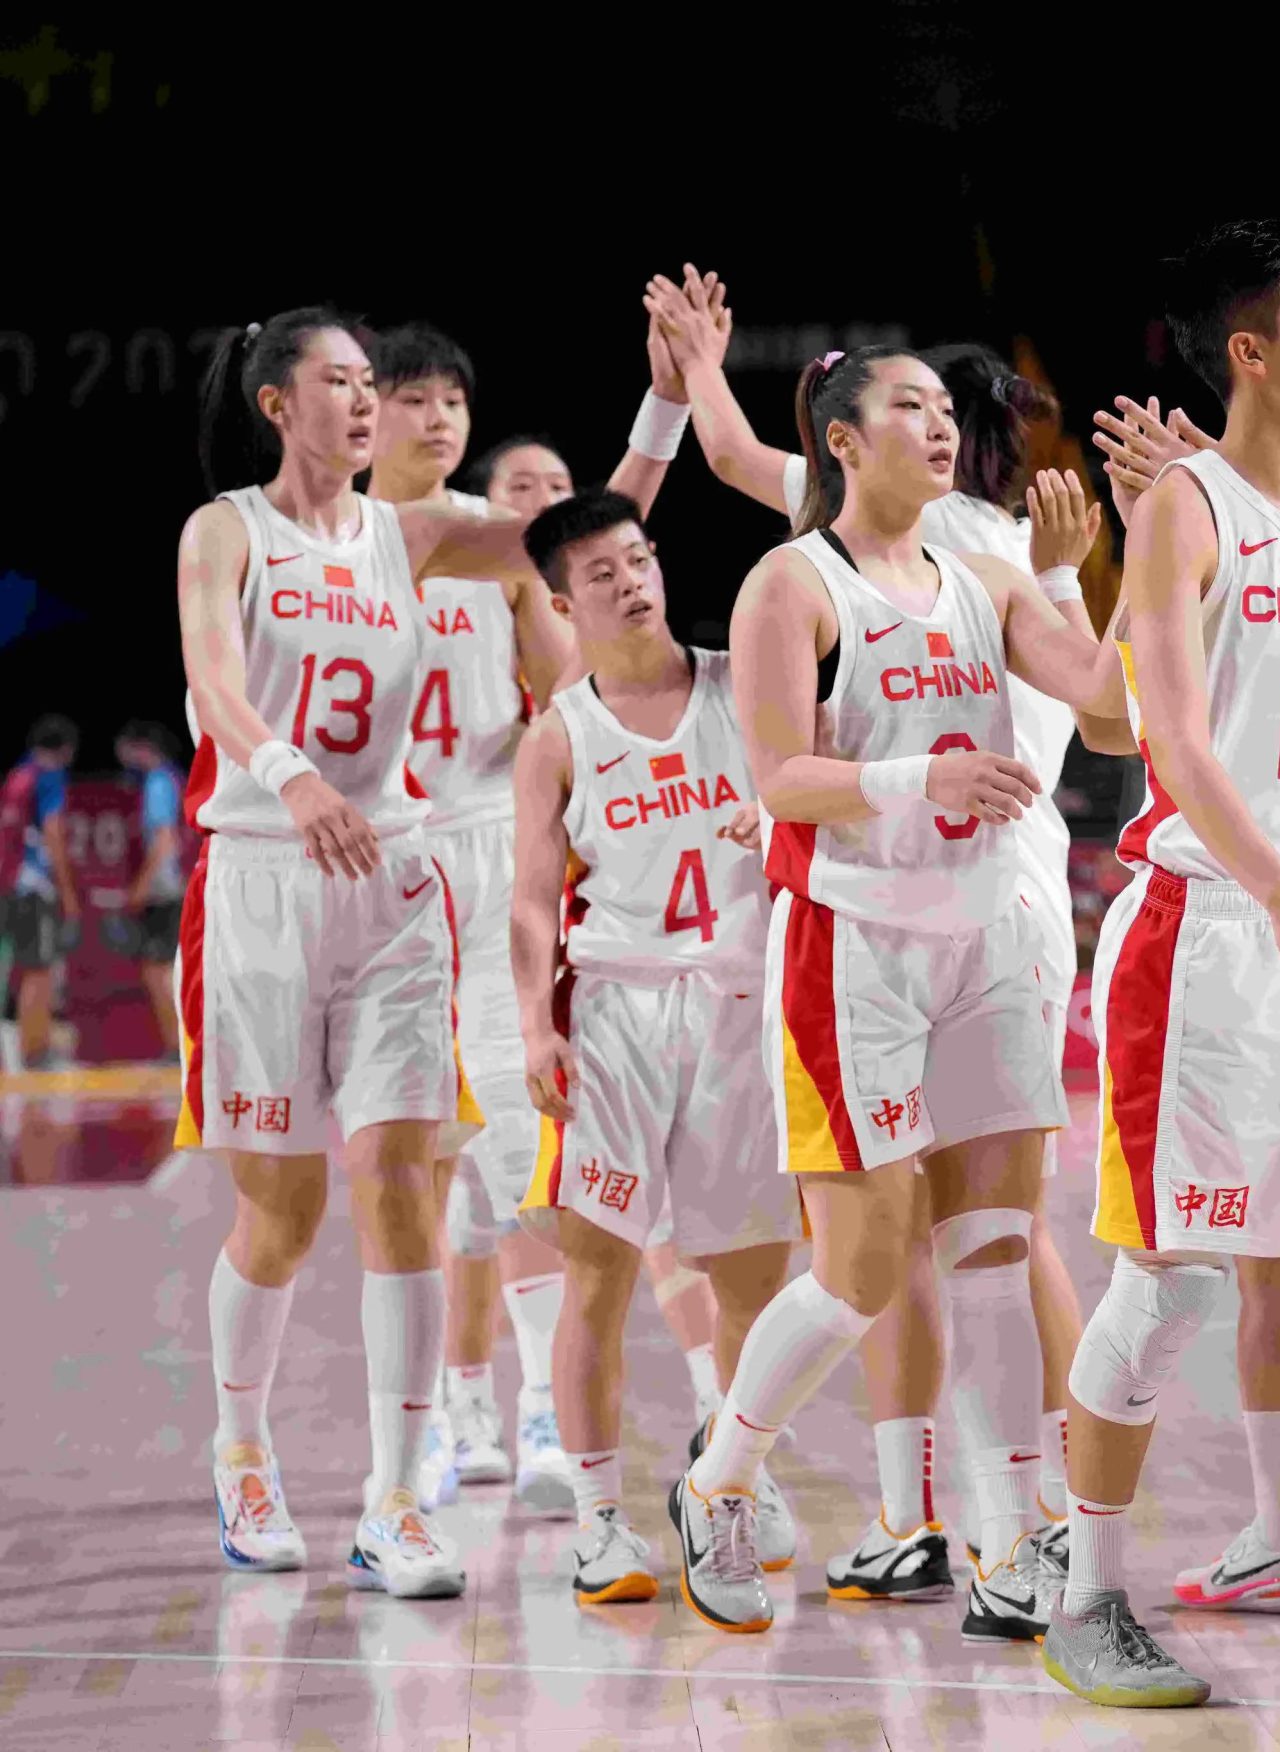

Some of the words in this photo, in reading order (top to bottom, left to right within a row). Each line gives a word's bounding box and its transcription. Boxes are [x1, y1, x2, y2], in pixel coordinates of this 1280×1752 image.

[271, 589, 399, 631] CHINA
[291, 653, 374, 755] 13
[880, 661, 998, 702] CHINA
[411, 668, 460, 758] 4
[604, 773, 741, 830] CHINA
[664, 848, 719, 944] 4
[222, 1090, 291, 1134] 中国
[581, 1157, 638, 1213] 中国
[1175, 1184, 1249, 1228] 中国
